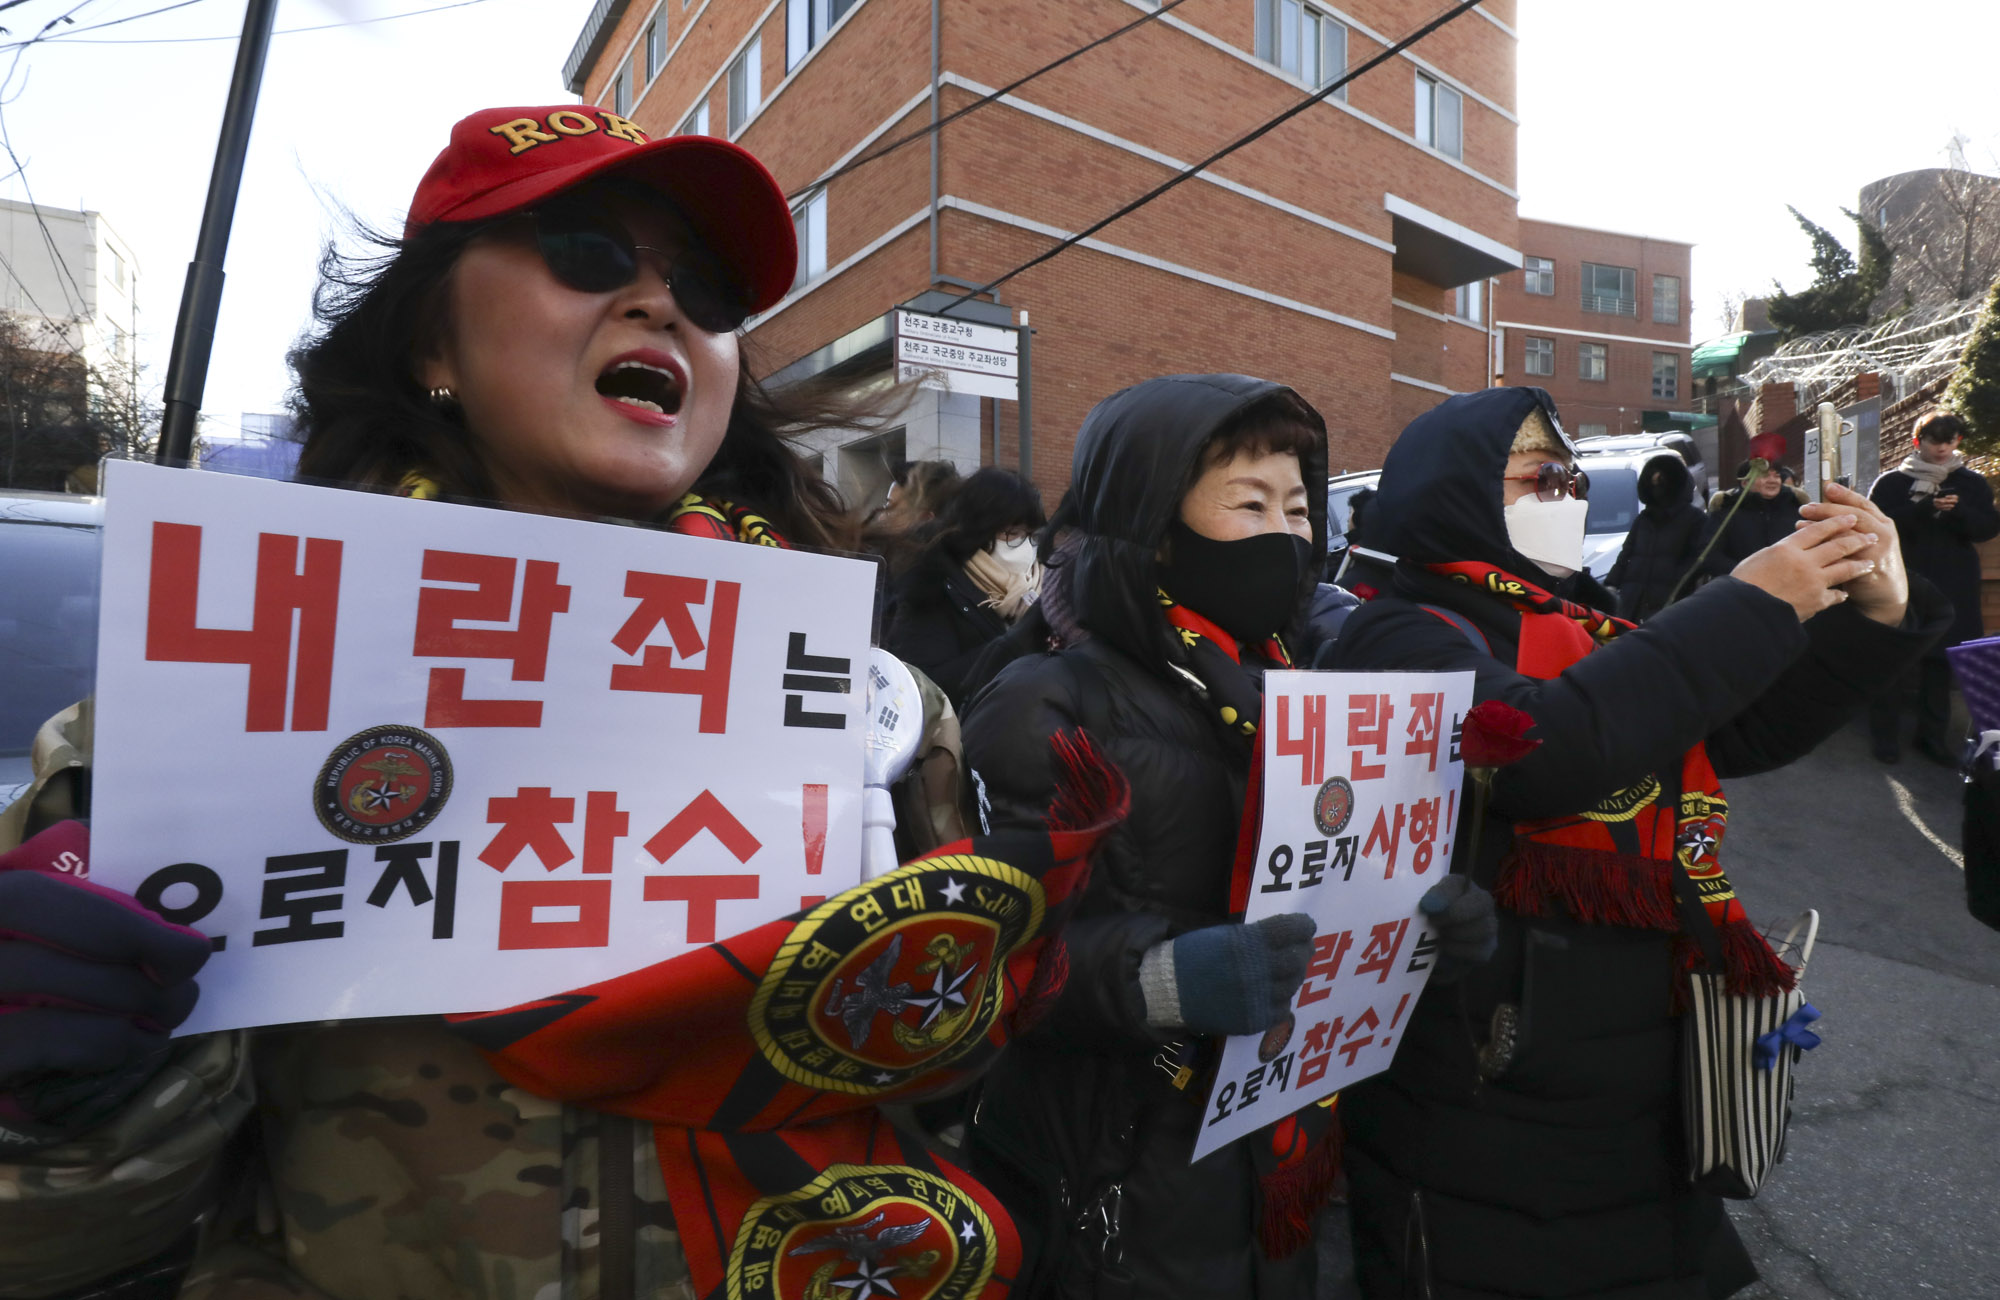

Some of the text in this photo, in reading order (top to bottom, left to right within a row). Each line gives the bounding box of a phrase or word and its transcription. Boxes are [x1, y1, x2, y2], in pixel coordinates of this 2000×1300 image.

[904, 316, 929, 329] 천주교
[932, 321, 973, 338] 군종교구청
[904, 341, 929, 354] 천주교
[933, 346, 965, 361] 국군중앙
[969, 352, 1008, 367] 주교좌성당
[146, 521, 851, 734] 내란죄는
[328, 735, 443, 798] REPUBLIC OF KOREA MARINE CORPS
[134, 783, 829, 953] 오로지 참수!
[1260, 834, 1360, 893] 오로지
[1361, 789, 1456, 880] 사형!
[850, 876, 927, 934] 연대
[1296, 917, 1439, 1009] 란죄는
[1207, 1051, 1295, 1127] 오로지
[1296, 993, 1412, 1090] 참수!
[820, 1175, 895, 1216] 예비역
[906, 1176, 957, 1222] 연대
